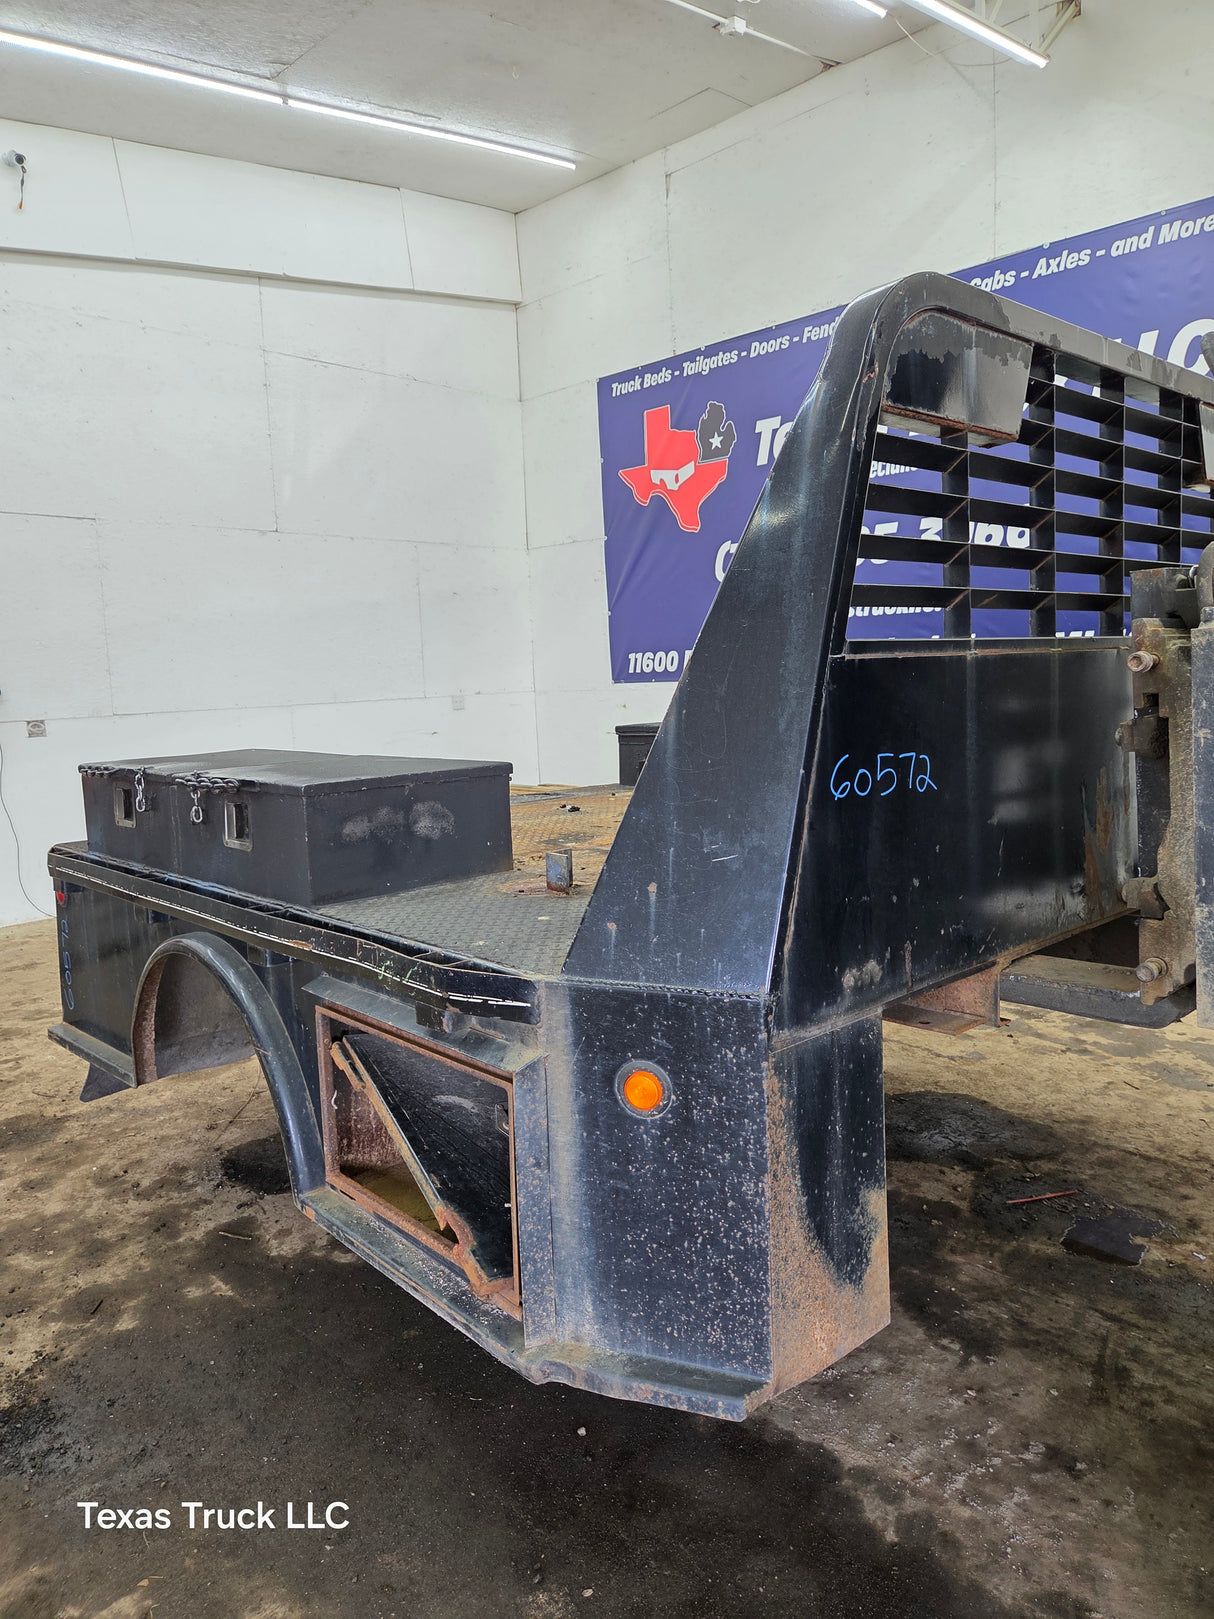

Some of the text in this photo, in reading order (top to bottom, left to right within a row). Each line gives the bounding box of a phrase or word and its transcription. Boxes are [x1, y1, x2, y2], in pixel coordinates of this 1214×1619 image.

[611, 375, 641, 397] Truck
[643, 367, 672, 388] Beds
[683, 349, 738, 377] Tailgates
[749, 334, 790, 358] Doors
[1032, 249, 1091, 279] Axles
[1110, 226, 1155, 257] and
[1157, 213, 1214, 246] More
[628, 650, 679, 673] 11600
[830, 752, 938, 801] 60572
